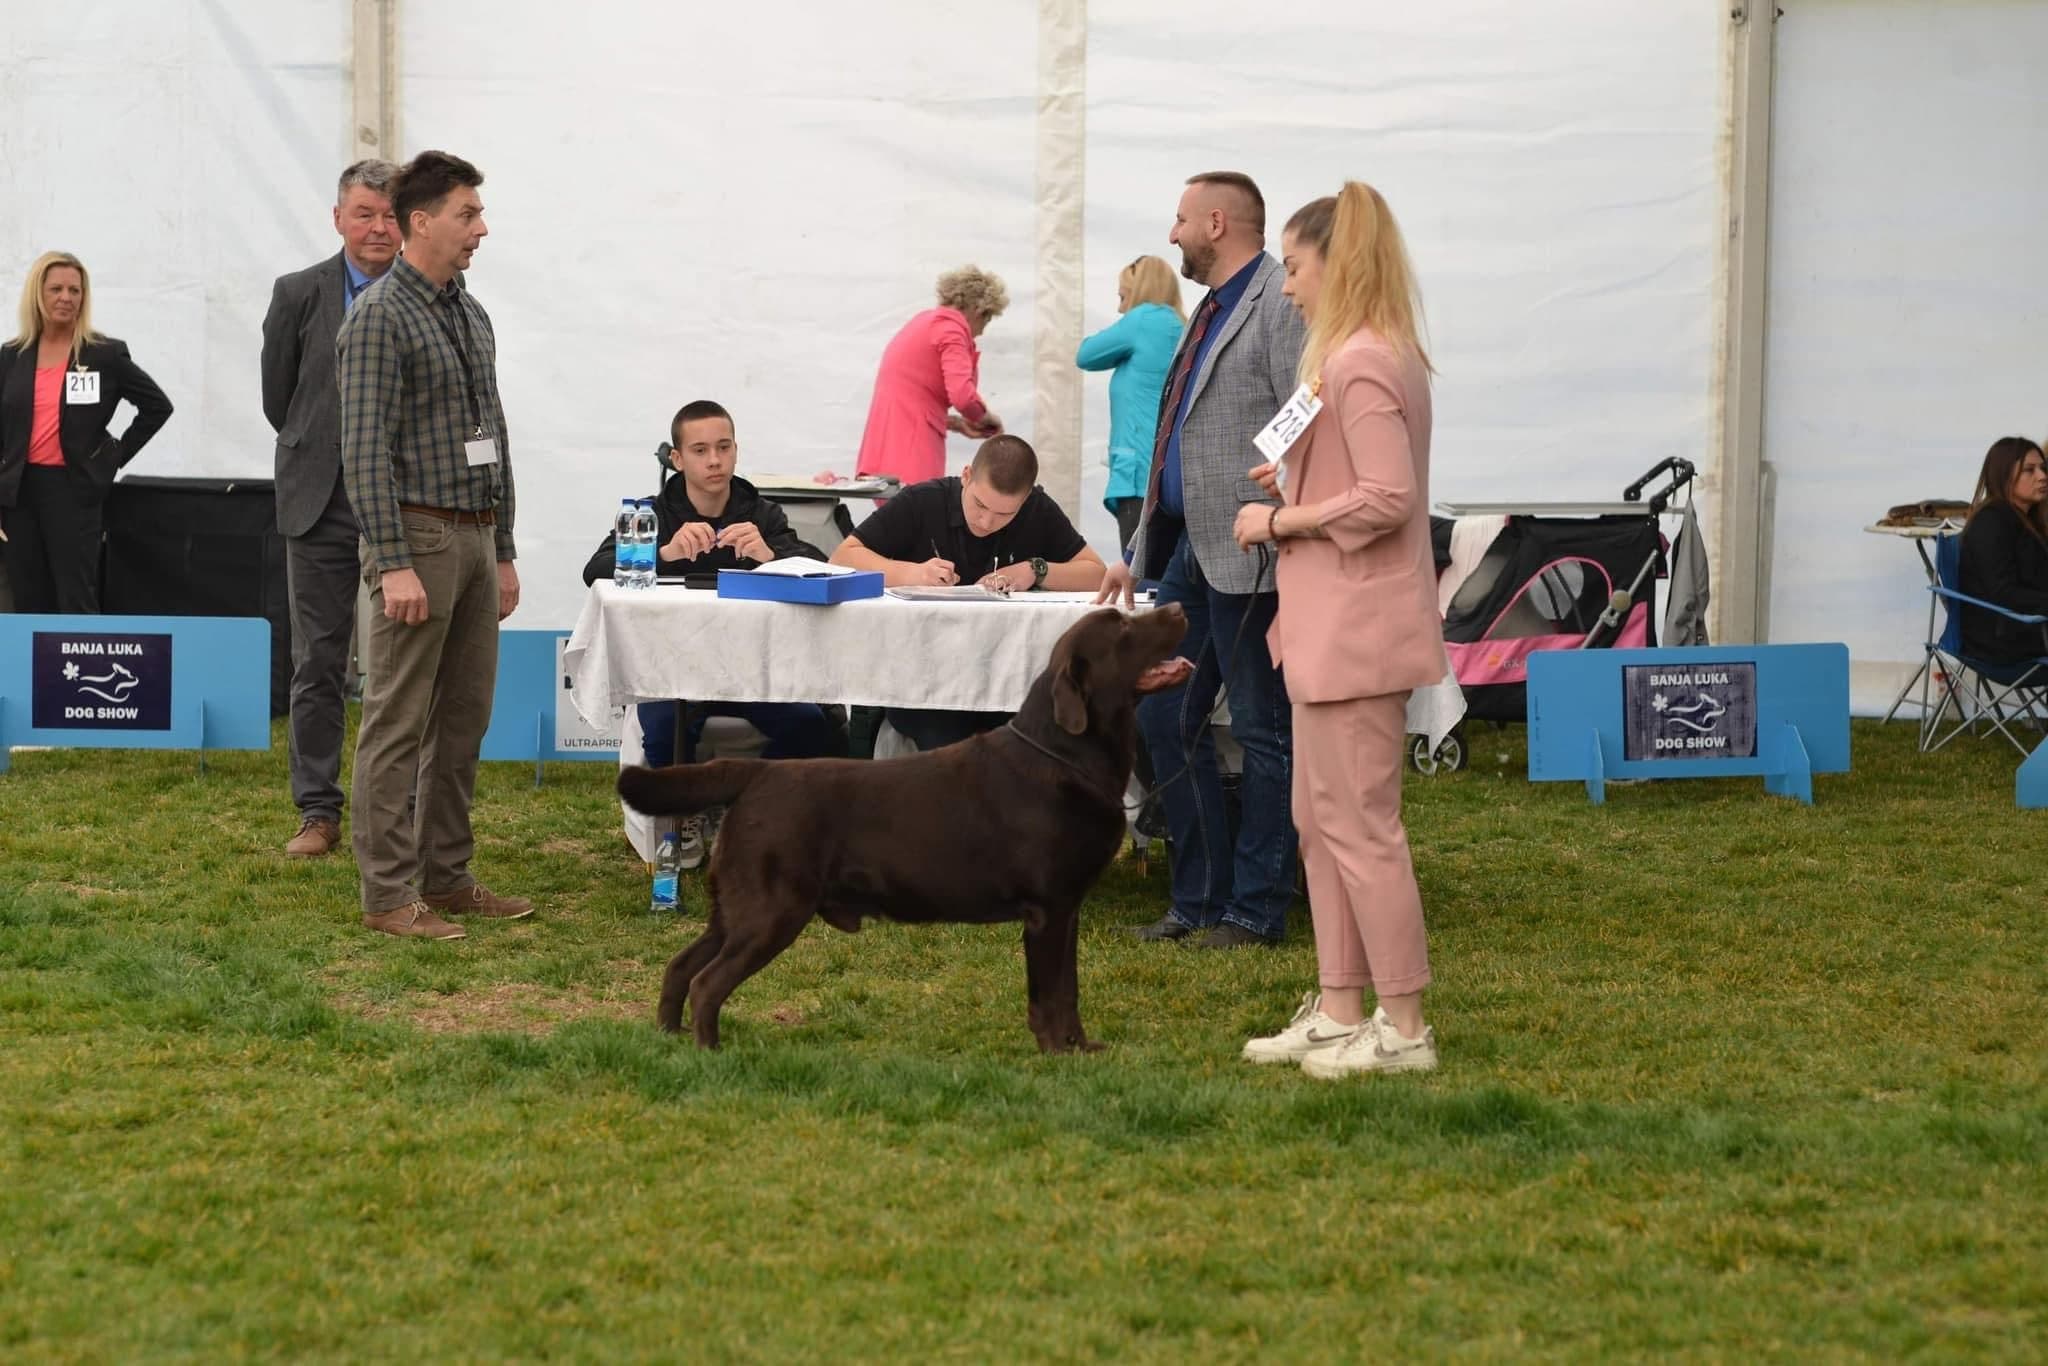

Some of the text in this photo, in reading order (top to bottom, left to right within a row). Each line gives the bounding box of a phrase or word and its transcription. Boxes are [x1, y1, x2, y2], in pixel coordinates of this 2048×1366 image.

[71, 375, 94, 392] 211
[61, 642, 143, 656] BANJA LUKA
[1650, 672, 1729, 686] BANJA LUKA
[64, 707, 139, 720] DOG SHOW
[563, 738, 623, 748] ULTRAPRE
[1655, 735, 1726, 750] DOG SHOW
